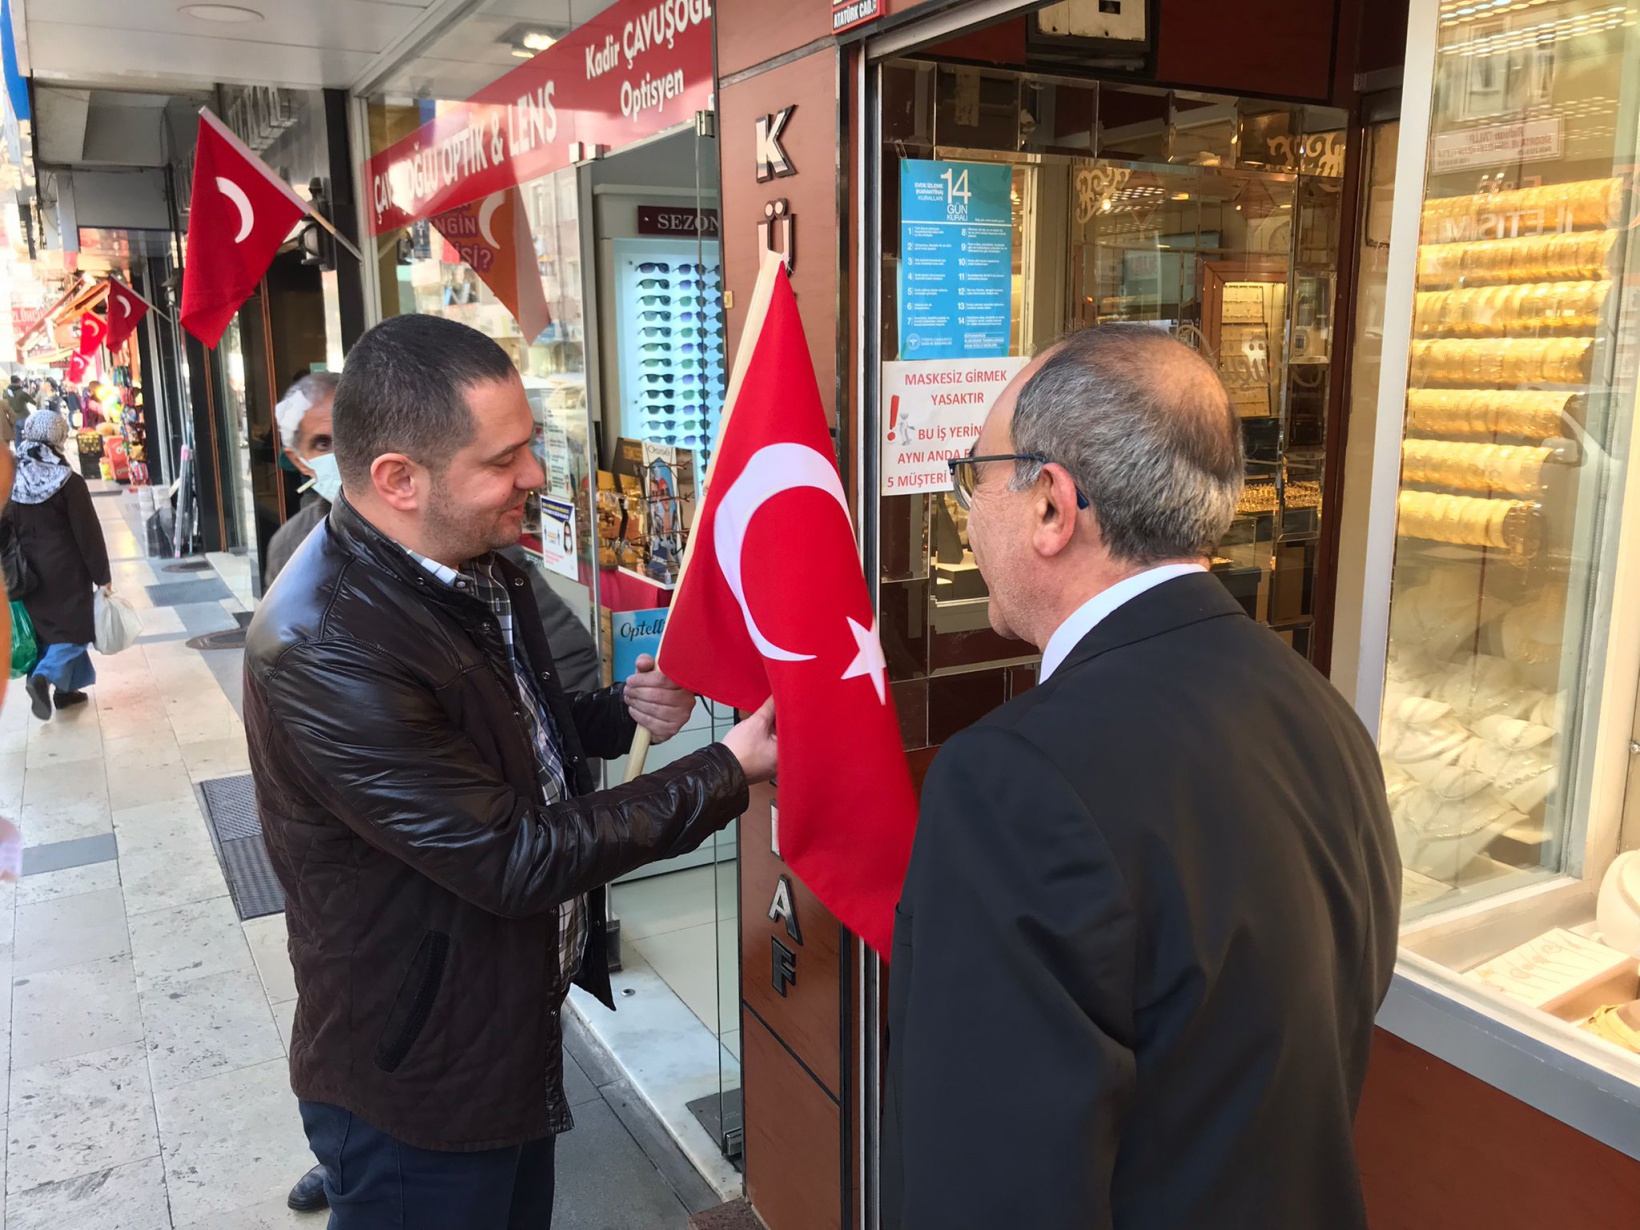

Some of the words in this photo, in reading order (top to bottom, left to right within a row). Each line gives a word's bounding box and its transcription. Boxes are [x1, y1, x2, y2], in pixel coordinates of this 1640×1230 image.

[585, 34, 620, 80] Kadir
[620, 68, 685, 122] Optisyen
[442, 112, 488, 186] OPTİK
[490, 112, 505, 166] &
[507, 81, 557, 158] LENS
[940, 168, 972, 205] 14
[946, 202, 968, 214] GÜN
[657, 213, 719, 231] SEZON
[904, 369, 963, 386] MASKESİZ
[965, 369, 1007, 383] GİRMEK
[931, 392, 985, 406] YASAKTIR
[918, 428, 934, 440] BU
[937, 425, 947, 441] İŞ
[897, 451, 925, 465] AYNI
[927, 449, 961, 462] ANDA
[887, 475, 894, 488] 5
[897, 472, 947, 488] MÜŞTERİ
